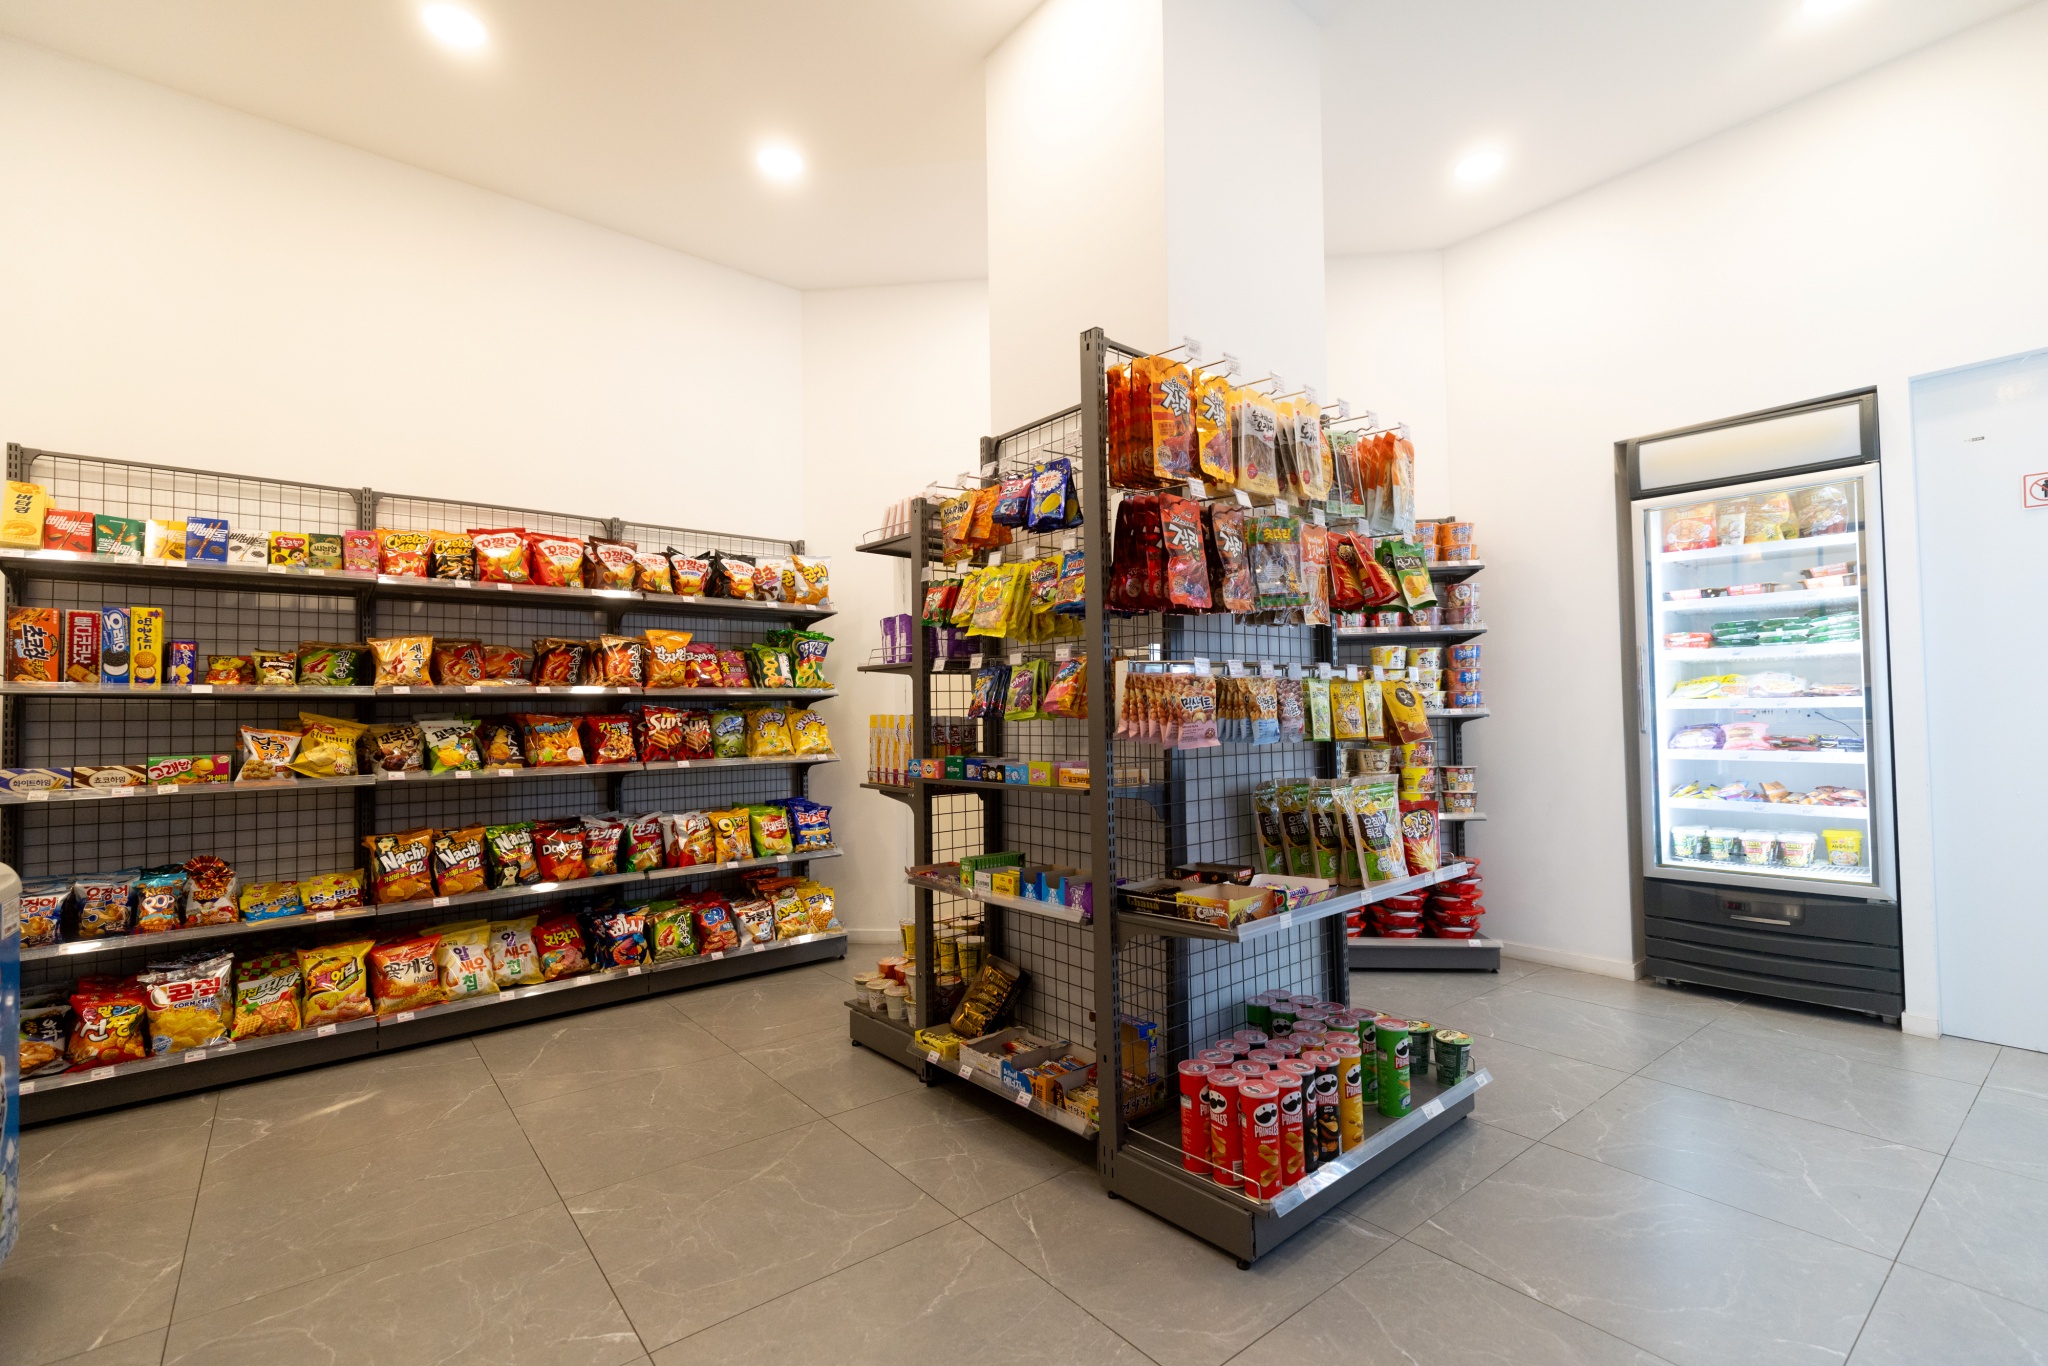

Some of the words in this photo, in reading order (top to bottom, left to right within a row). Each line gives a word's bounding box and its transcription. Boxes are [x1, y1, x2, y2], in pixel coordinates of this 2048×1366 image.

[1161, 383, 1191, 417] 질러
[1203, 395, 1227, 427] 질러
[14, 493, 33, 514] 버터링
[943, 500, 969, 518] HARIBO
[45, 515, 93, 534] 빼빼로
[187, 522, 229, 539] 빼빼로
[386, 533, 429, 549] Cheetos
[434, 539, 474, 554] Cheetos
[477, 536, 518, 548] 꼬깔콘
[1169, 523, 1199, 552] 질러
[1220, 532, 1243, 558] 질러
[313, 543, 338, 554] 씨리얼
[544, 544, 582, 558] 꼬깔콘
[600, 550, 634, 564] 꼬깔콘
[674, 559, 707, 572] 꼬깔콘
[803, 564, 828, 583] 콘치
[753, 565, 777, 586] 콘초
[782, 570, 795, 587] 콘
[73, 616, 92, 664] 빠다코코낫
[104, 612, 125, 653] 오레오
[22, 624, 50, 661] 초코칩
[799, 641, 826, 657] 양파링
[628, 644, 642, 680] 새우깡
[654, 645, 687, 663] 감자깡
[334, 650, 351, 679] 새우깡
[462, 649, 482, 679] 새우깡
[509, 657, 522, 679] 새우
[567, 646, 583, 683] 새우깡
[432, 725, 472, 742] 꼬북칩
[650, 713, 683, 735] Sun
[250, 734, 286, 755] 땅콩
[380, 725, 416, 745] 꼬북칩
[150, 759, 191, 779] 고래밥
[12, 778, 52, 787] 화이트하임
[760, 818, 788, 836] 포테토칩
[797, 810, 828, 825] 포스틱
[588, 828, 622, 841] 포카칩
[380, 845, 427, 873] Nacho
[438, 843, 481, 869] Nacho
[85, 885, 129, 902] 오징어
[777, 900, 805, 921] 사또밥
[501, 931, 517, 947] 알
[543, 928, 581, 947] 자갈치
[675, 914, 691, 946] 새우깡
[453, 945, 470, 962] 알
[504, 943, 532, 959] 새우
[383, 953, 436, 980] 꽃게랑
[459, 958, 487, 974] 새우
[506, 959, 522, 975] 칩
[167, 976, 221, 1003] 콘칩
[462, 973, 478, 992] 칩
[174, 1000, 197, 1009] CORN
[74, 1013, 138, 1043] 신짱
[1316, 1091, 1339, 1105] PRINGLES
[1254, 1122, 1279, 1138] PRINGLES
